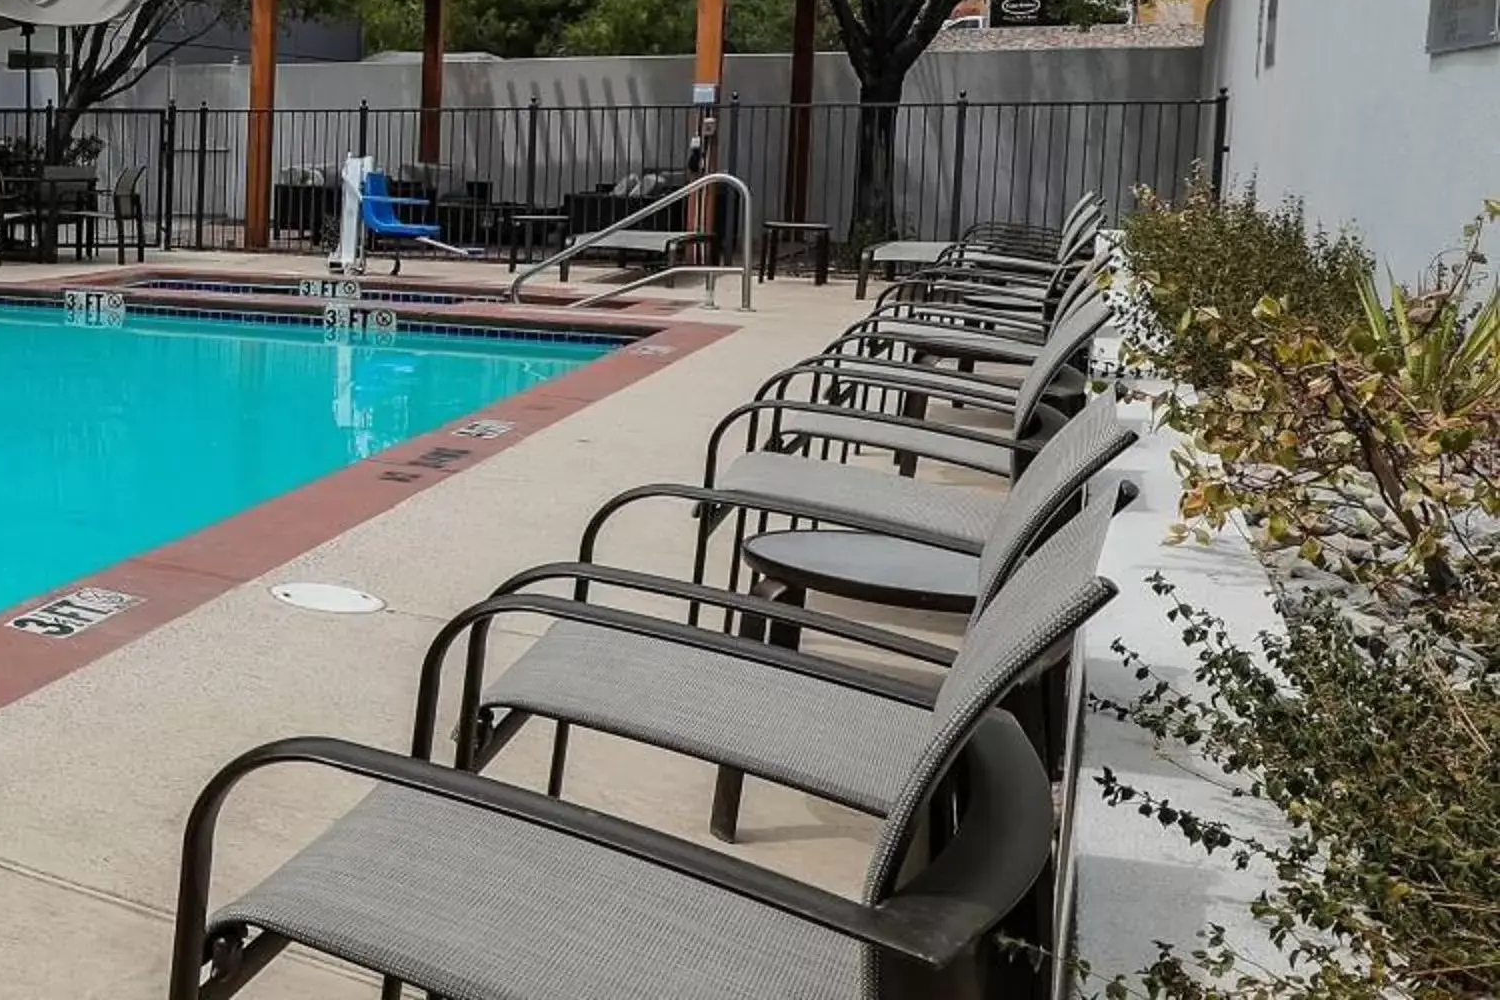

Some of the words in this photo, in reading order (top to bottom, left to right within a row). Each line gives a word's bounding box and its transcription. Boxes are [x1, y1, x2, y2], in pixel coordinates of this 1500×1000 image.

[321, 281, 337, 298] FT
[86, 293, 103, 311] FT
[349, 308, 369, 328] FT
[41, 600, 112, 622] FT
